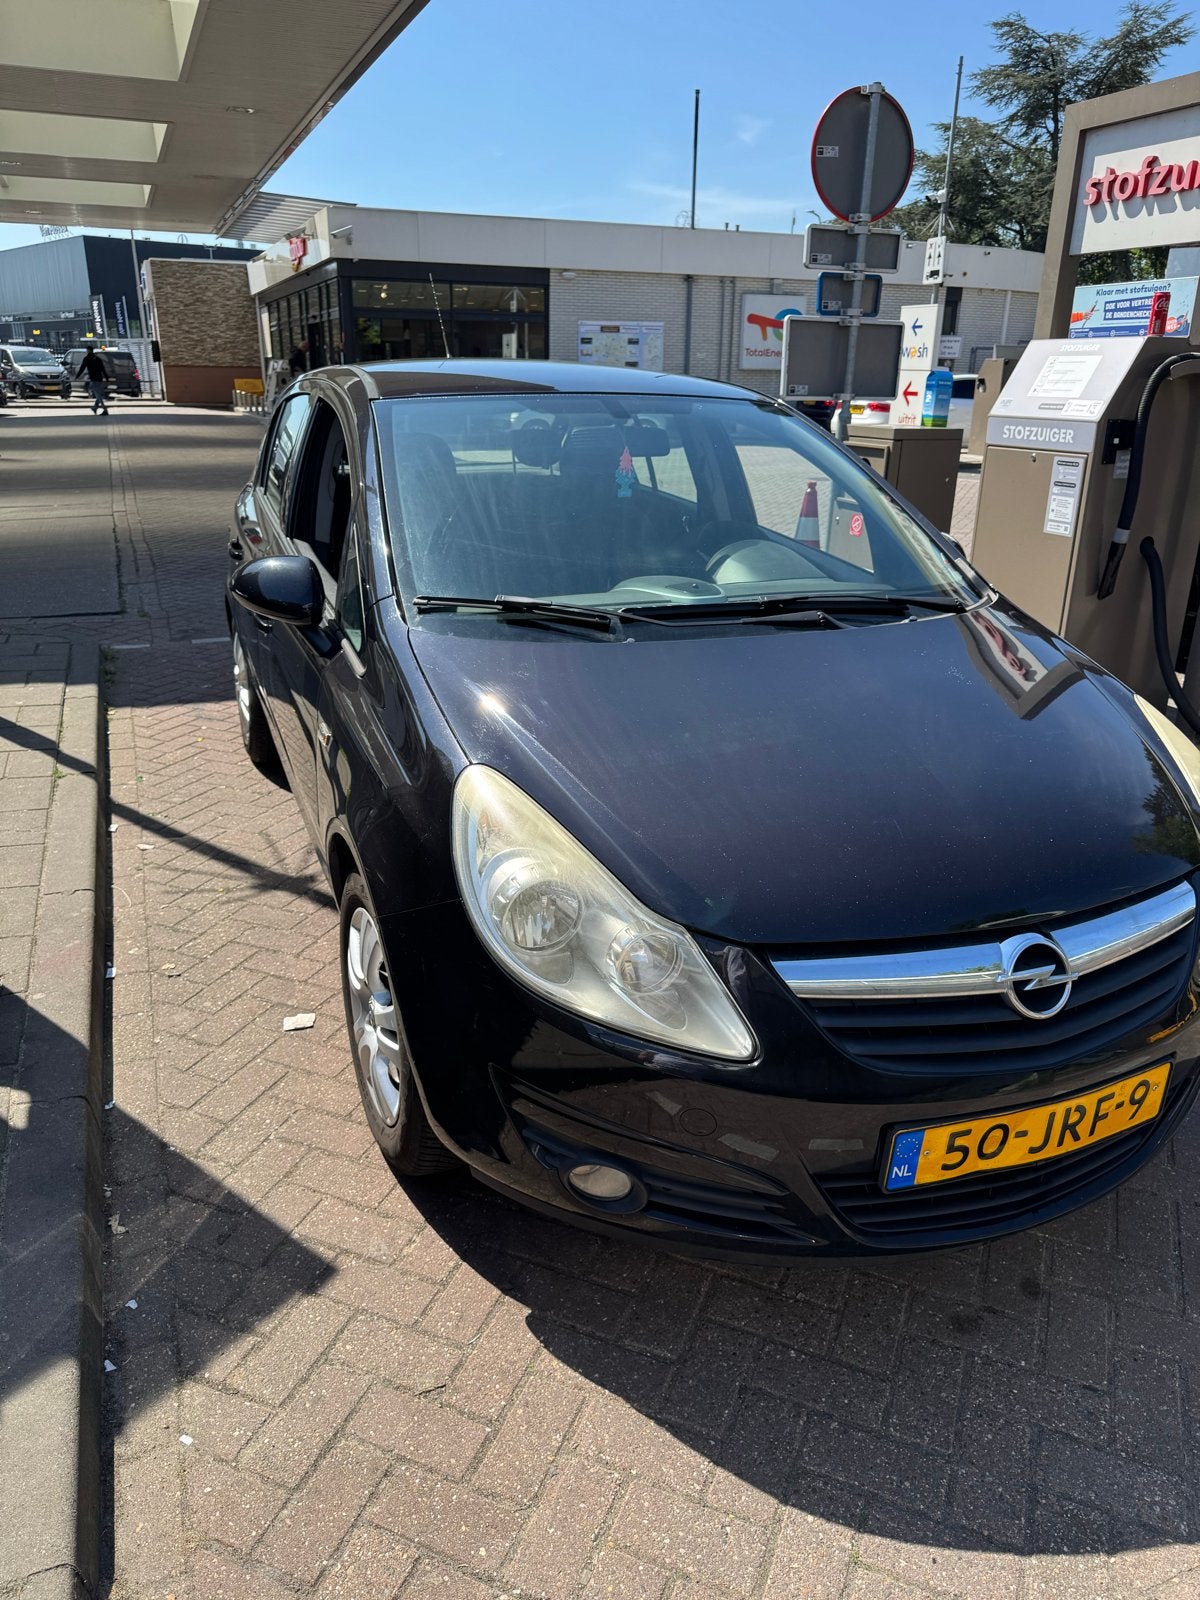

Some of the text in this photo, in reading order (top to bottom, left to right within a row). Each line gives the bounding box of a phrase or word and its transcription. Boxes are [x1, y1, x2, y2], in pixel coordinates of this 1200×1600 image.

[1096, 288, 1114, 296] Klaar
[1115, 287, 1128, 295] met
[1132, 298, 1153, 307] VERTRE
[745, 347, 783, 358] TotalEne
[1002, 425, 1074, 443] STOFZUIGER
[892, 1080, 1151, 1179] NL 50-JRF-9
